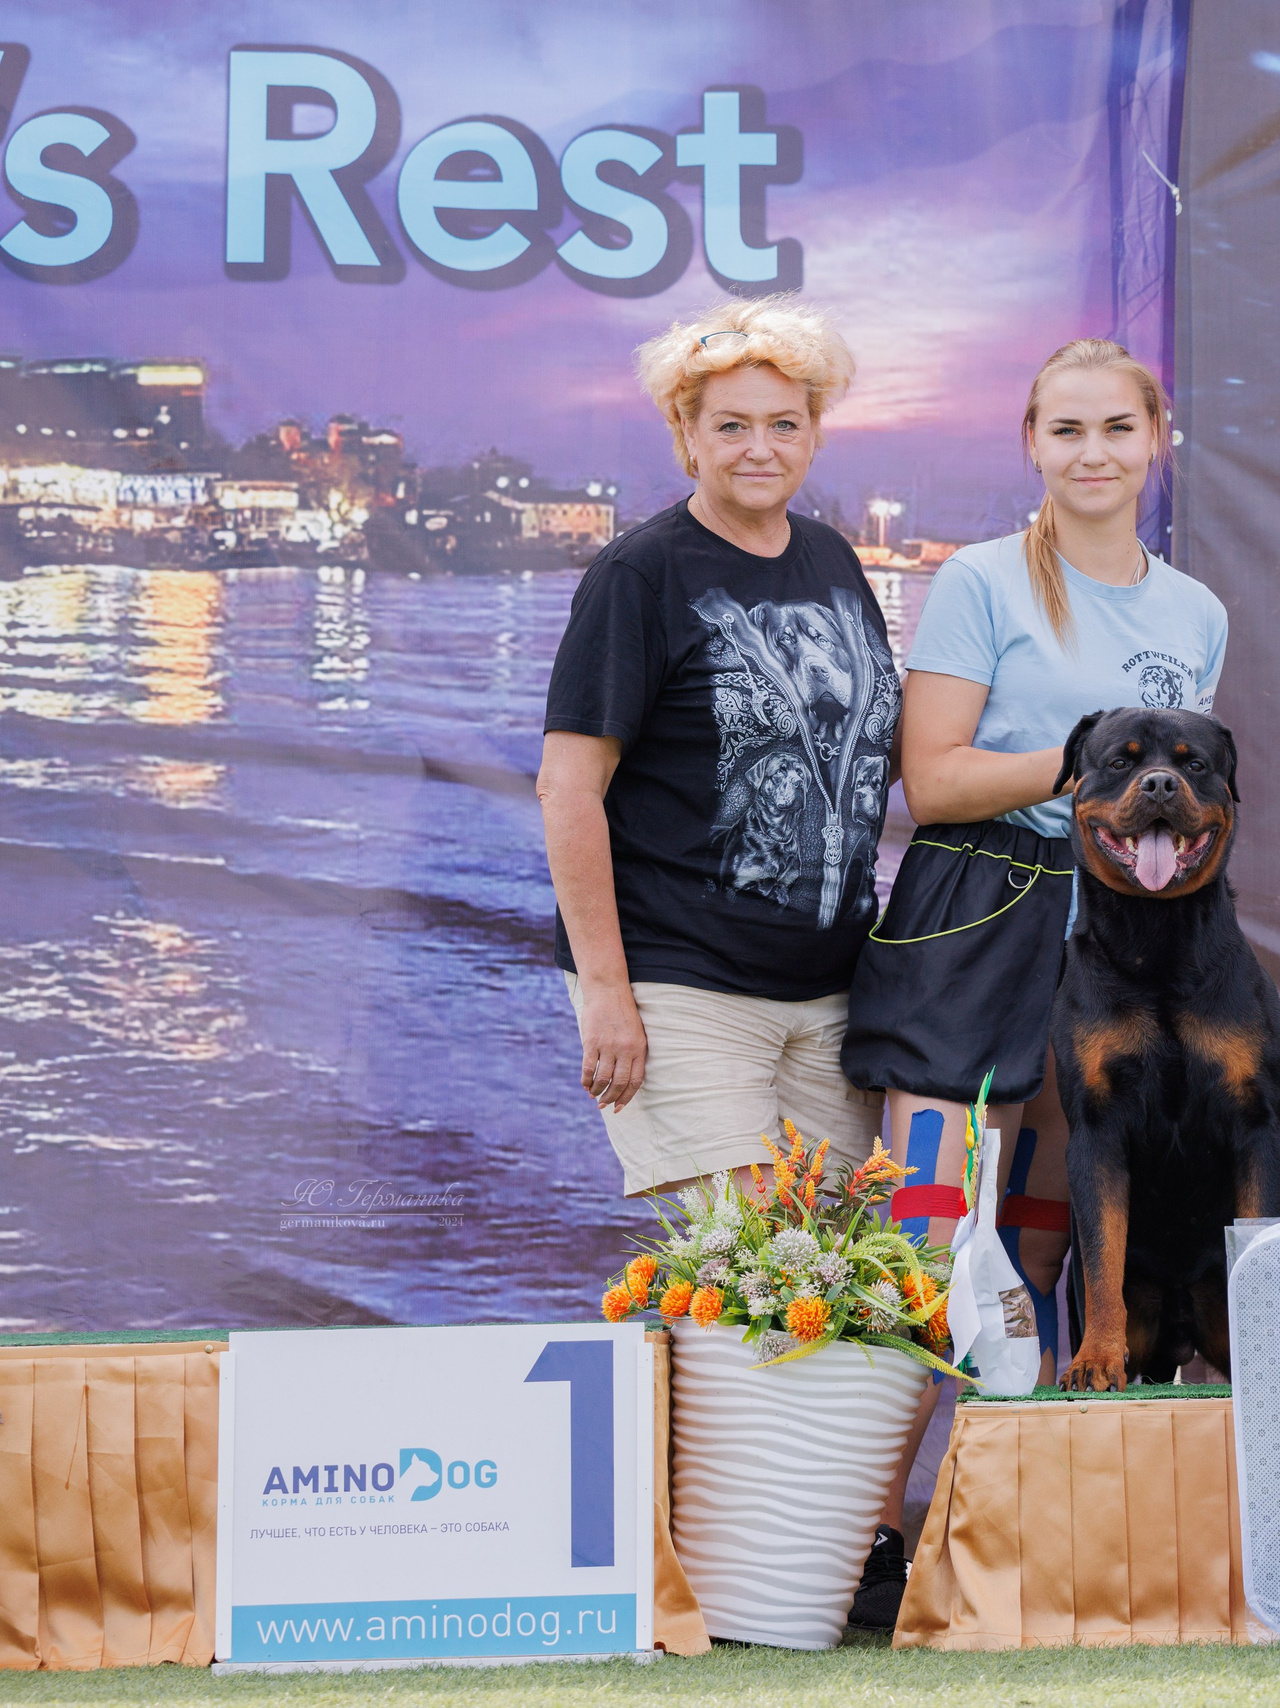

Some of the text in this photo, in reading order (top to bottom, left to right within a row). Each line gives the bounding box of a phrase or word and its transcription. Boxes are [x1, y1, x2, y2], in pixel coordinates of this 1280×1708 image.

[225, 43, 803, 299] Rest
[523, 1339, 615, 1568] 1
[262, 1495, 396, 1507] КОРМА ДЛЯ СОБАК
[250, 1527, 301, 1540] ЛУЧШЕЕ,
[304, 1526, 326, 1538] ЧТО
[329, 1525, 357, 1537] ЕСТЬ
[359, 1525, 367, 1536] У
[369, 1523, 428, 1536] ЧЕЛОВЕКА
[440, 1522, 462, 1533] ЭТО
[465, 1521, 510, 1533] СОБАКА
[256, 1602, 617, 1647] www.aminodog.ru
